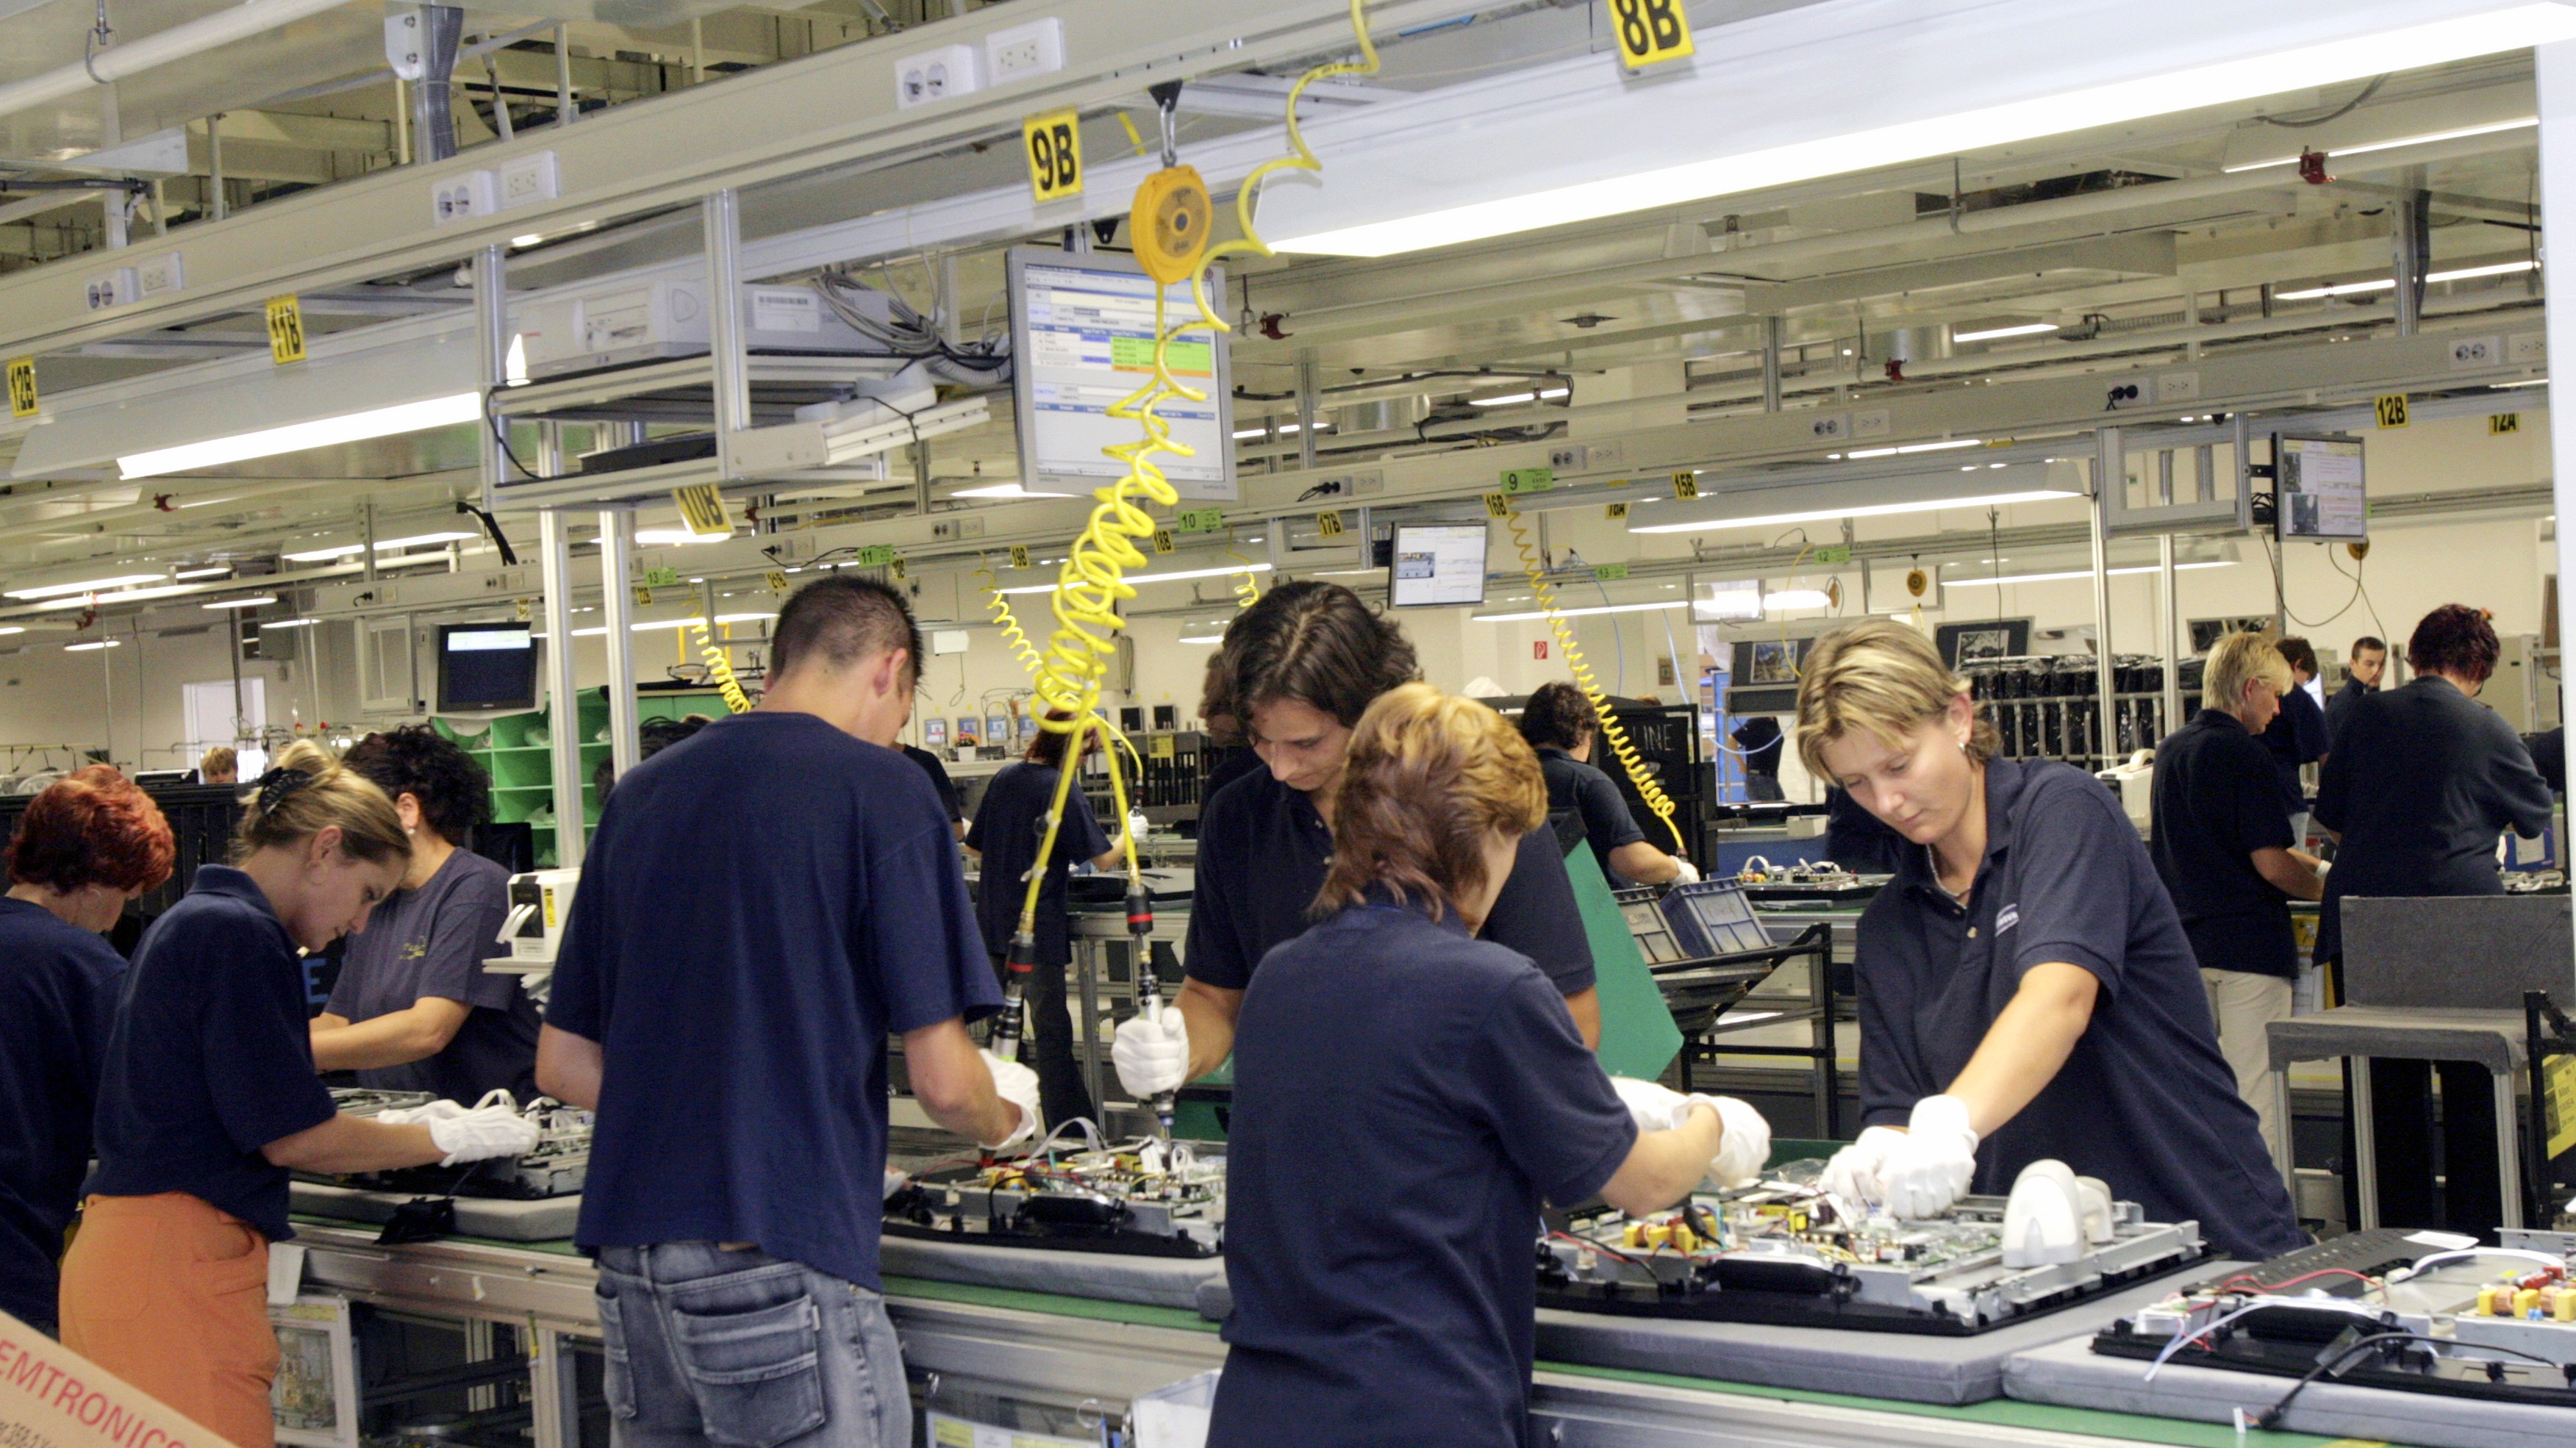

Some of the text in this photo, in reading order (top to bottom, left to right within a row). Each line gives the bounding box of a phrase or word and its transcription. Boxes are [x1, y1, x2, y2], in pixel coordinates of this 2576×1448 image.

[1616, 0, 1682, 55] 8B
[1032, 123, 1076, 192] 9B
[271, 304, 301, 358] 11B
[12, 365, 34, 412] 12B
[2378, 396, 2405, 426] 12B
[2491, 413, 2516, 432] 12A
[1509, 473, 1518, 491] 9
[1675, 473, 1696, 498] 15B
[678, 485, 723, 528] 10B
[1486, 494, 1507, 517] 16B
[1182, 513, 1196, 528] 10
[1320, 513, 1341, 535] 17B
[1153, 530, 1171, 552] 18B
[862, 551, 873, 564] 11
[1012, 546, 1028, 567] 19B
[1818, 551, 1829, 562] 12
[648, 571, 659, 586] 13
[1632, 724, 1675, 752] LINE
[0, 1339, 187, 1448] EMTRONIC
